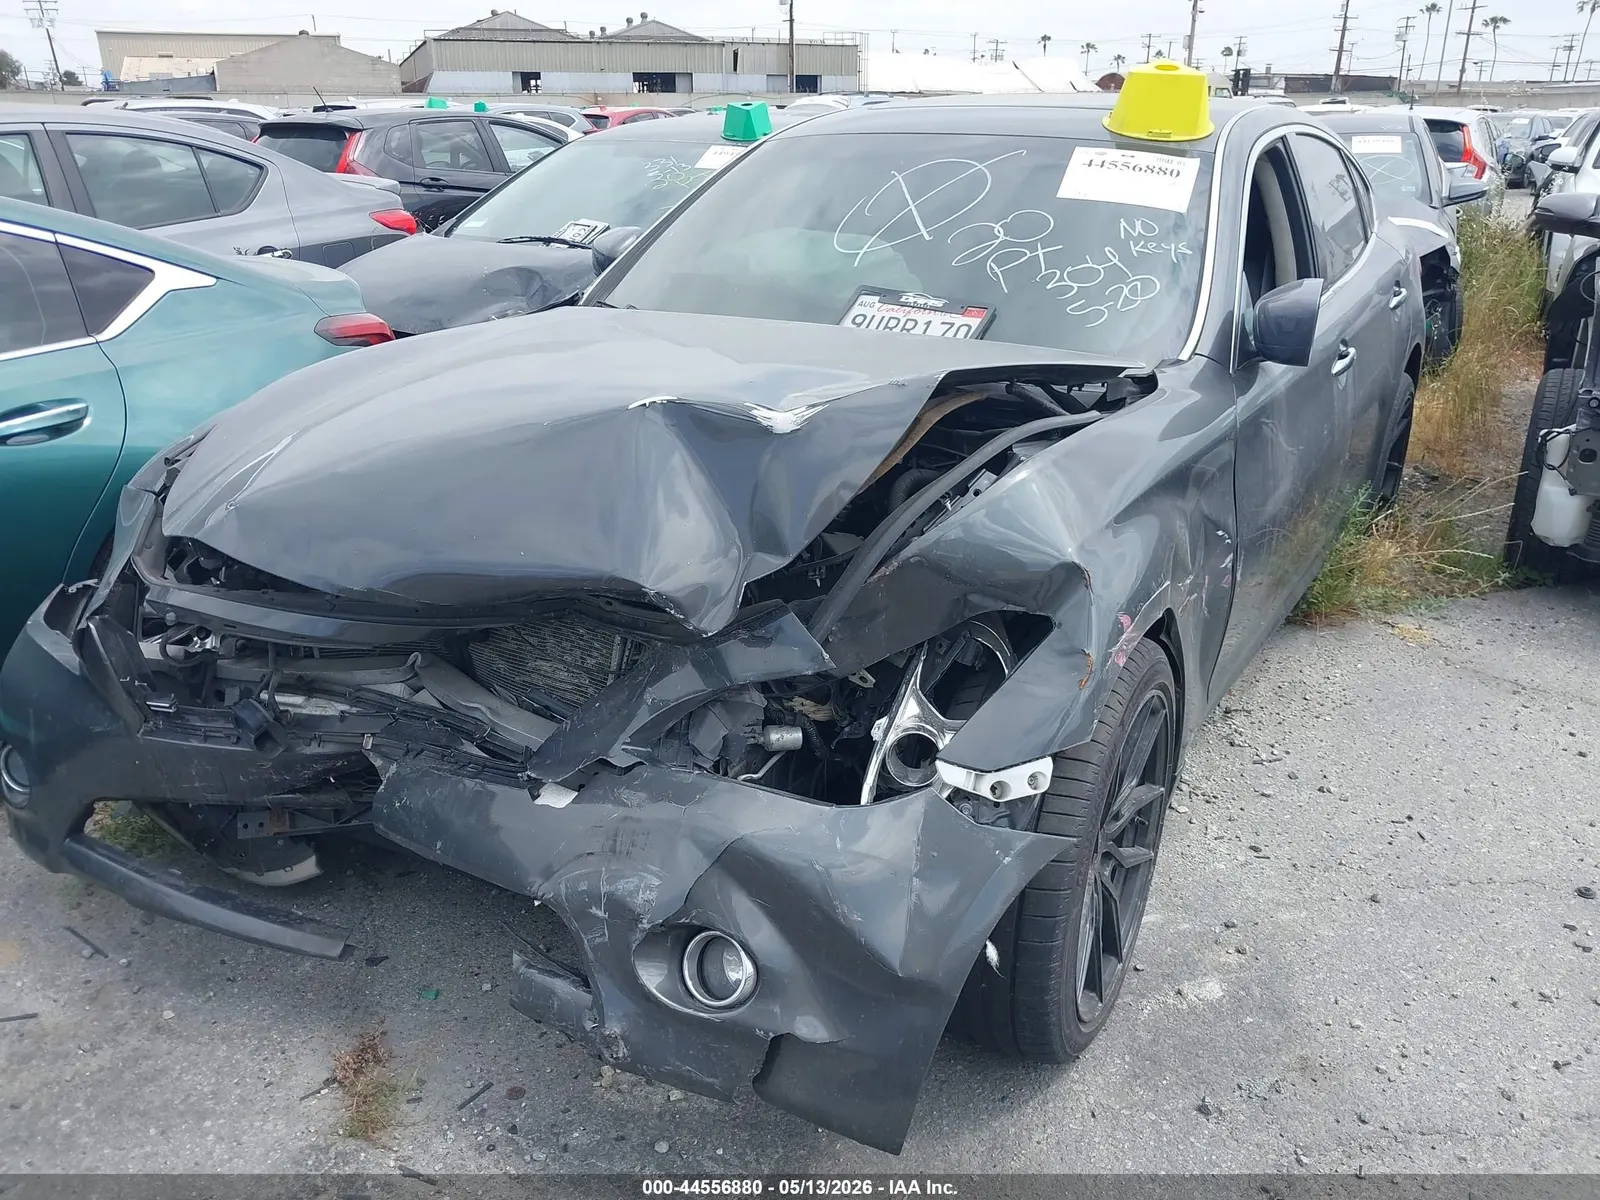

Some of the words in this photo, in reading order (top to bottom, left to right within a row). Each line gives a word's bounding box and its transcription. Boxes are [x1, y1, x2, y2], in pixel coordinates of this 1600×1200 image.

[1082, 159, 1181, 179] 44556880
[857, 300, 875, 309] AUG
[877, 303, 962, 318] Californ
